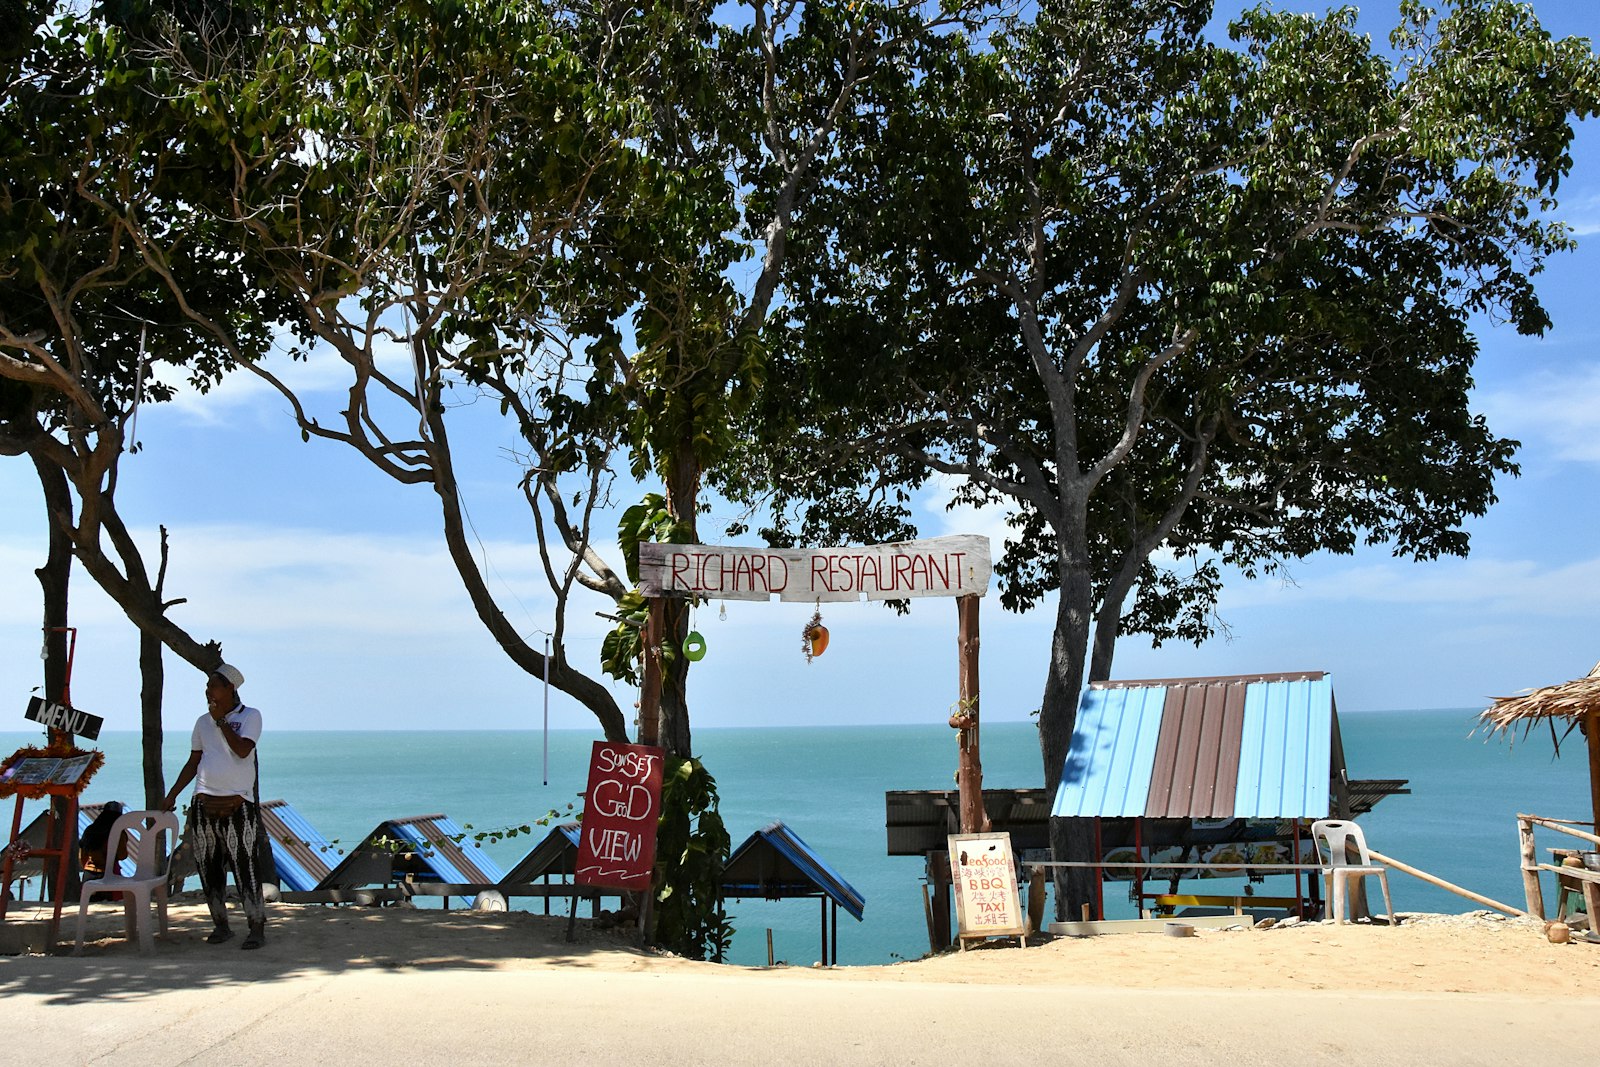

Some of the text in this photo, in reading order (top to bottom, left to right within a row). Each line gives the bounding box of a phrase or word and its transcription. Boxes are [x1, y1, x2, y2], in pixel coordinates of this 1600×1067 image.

[671, 552, 967, 592] RICHARD RESTAURANT
[36, 700, 88, 734] MENU
[589, 828, 641, 863] VIEW
[962, 853, 1006, 867] eafood
[970, 878, 1006, 890] BBQ
[976, 902, 1005, 913] TAXI
